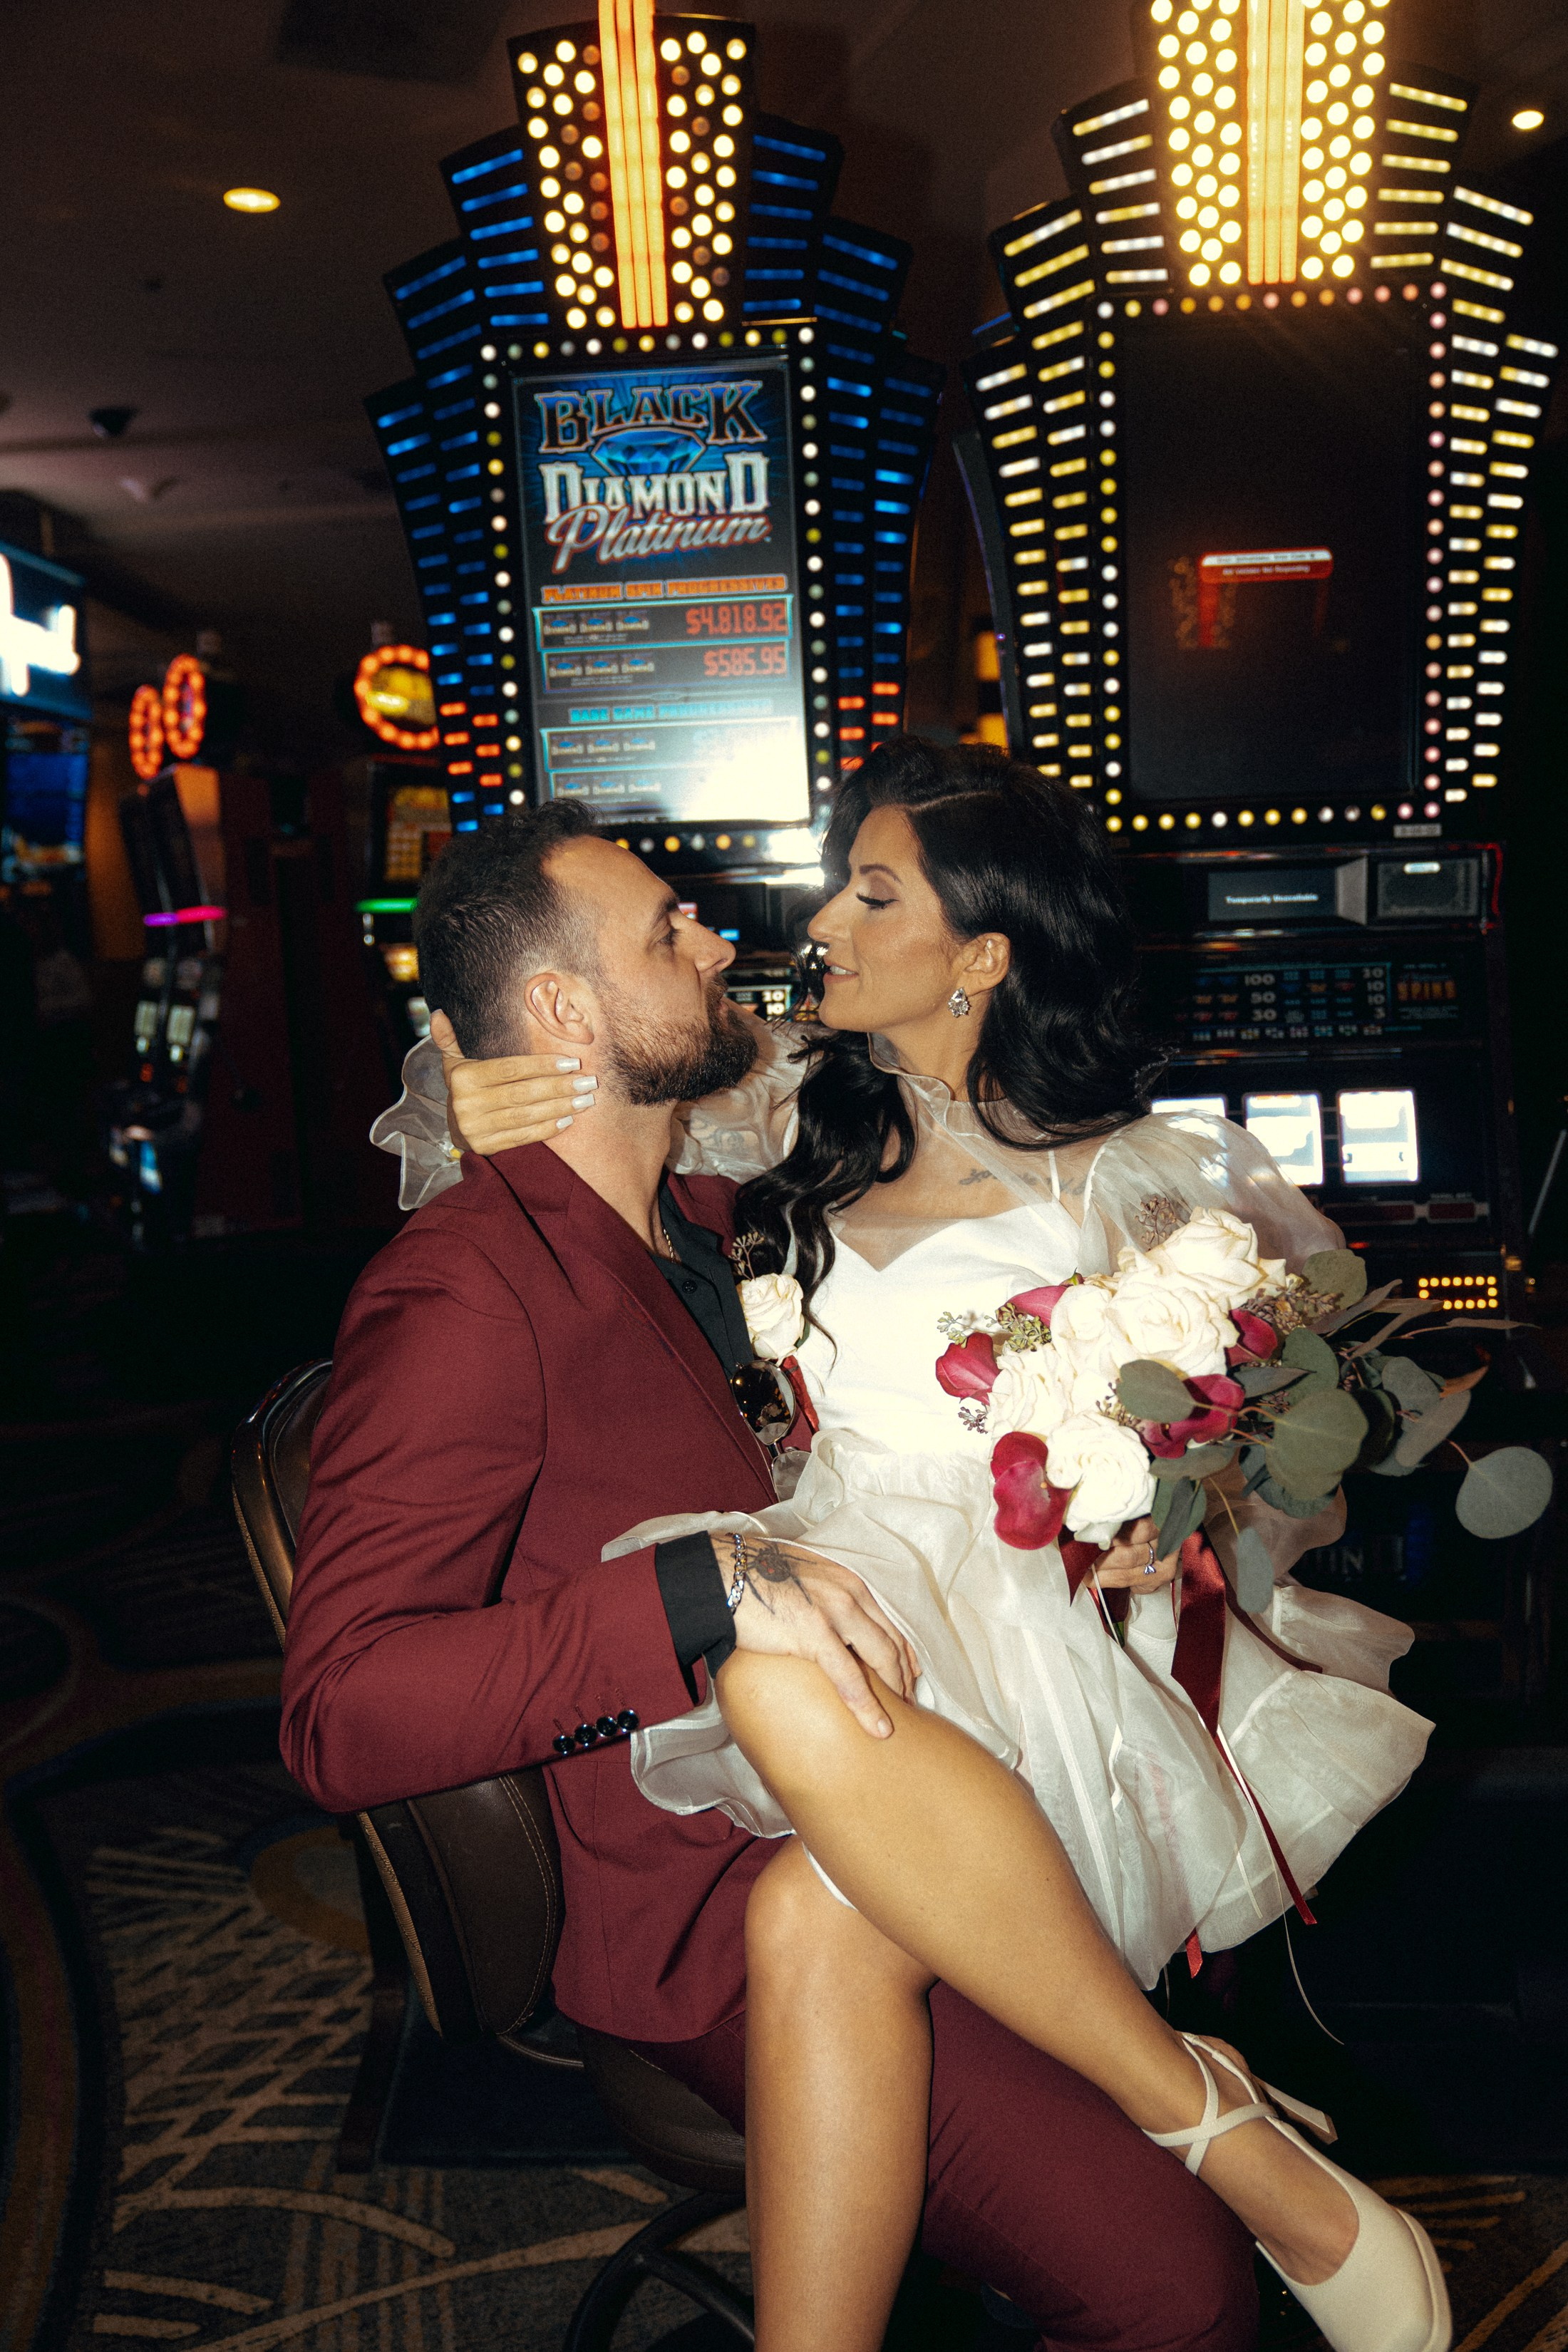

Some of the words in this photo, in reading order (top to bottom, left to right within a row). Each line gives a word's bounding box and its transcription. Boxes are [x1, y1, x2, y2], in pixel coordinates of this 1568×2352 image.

[534, 380, 768, 453] BLACK
[538, 451, 770, 523] DIAMOND
[546, 502, 772, 573] Platinum
[541, 582, 623, 604] PLATINUM
[624, 580, 664, 599] SPIN
[666, 574, 788, 597] PROGRESSIVES
[703, 645, 786, 676] $585.95
[1244, 973, 1276, 986] 100
[1366, 980, 1385, 992] 10
[766, 1003, 785, 1016] 10
[1367, 993, 1386, 1006] 10
